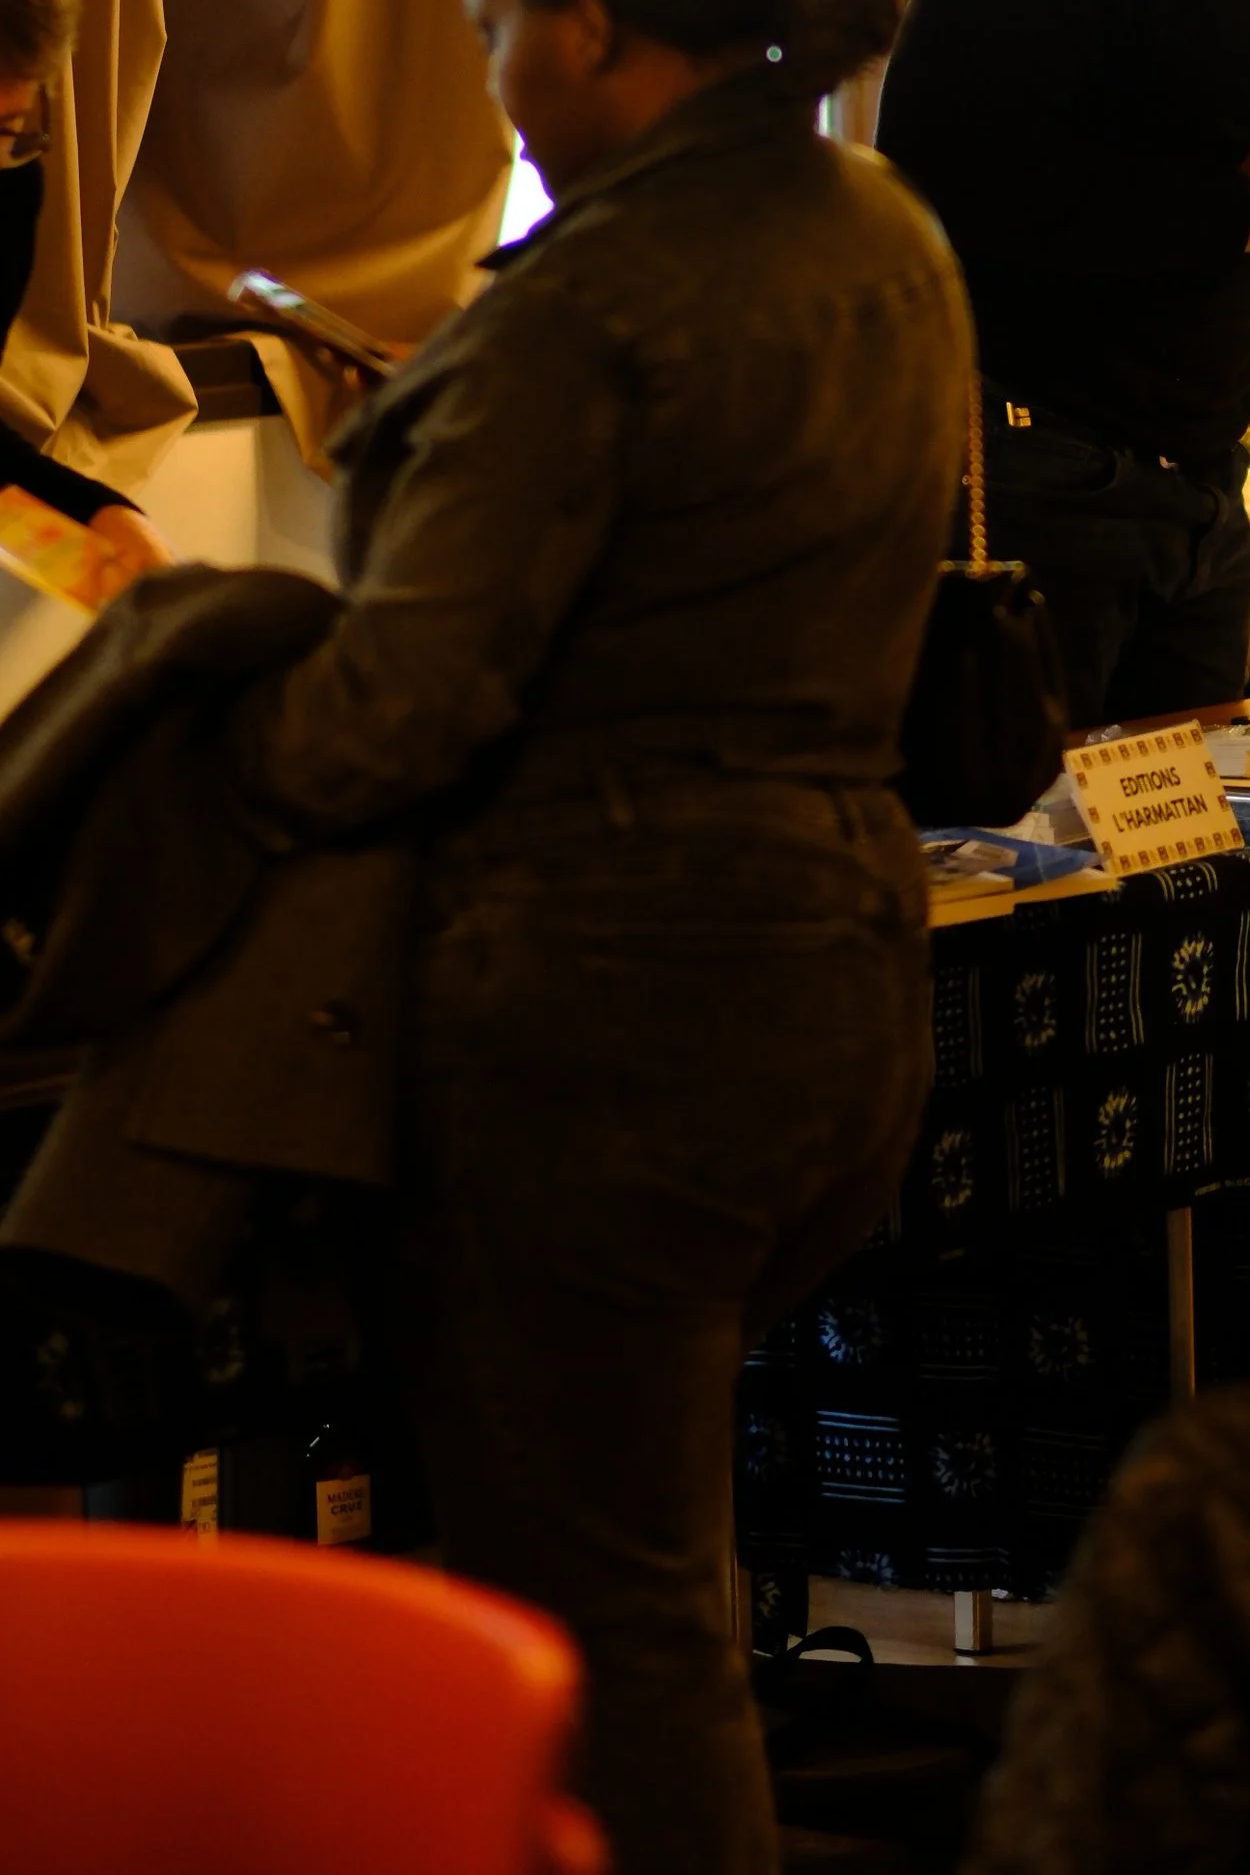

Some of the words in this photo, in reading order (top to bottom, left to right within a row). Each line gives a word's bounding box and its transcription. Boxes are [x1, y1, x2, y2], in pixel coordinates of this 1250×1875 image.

[1119, 766, 1182, 798] EDITIONS
[1112, 793, 1209, 833] L'HARMATTAN
[331, 1500, 363, 1516] CRUZ
